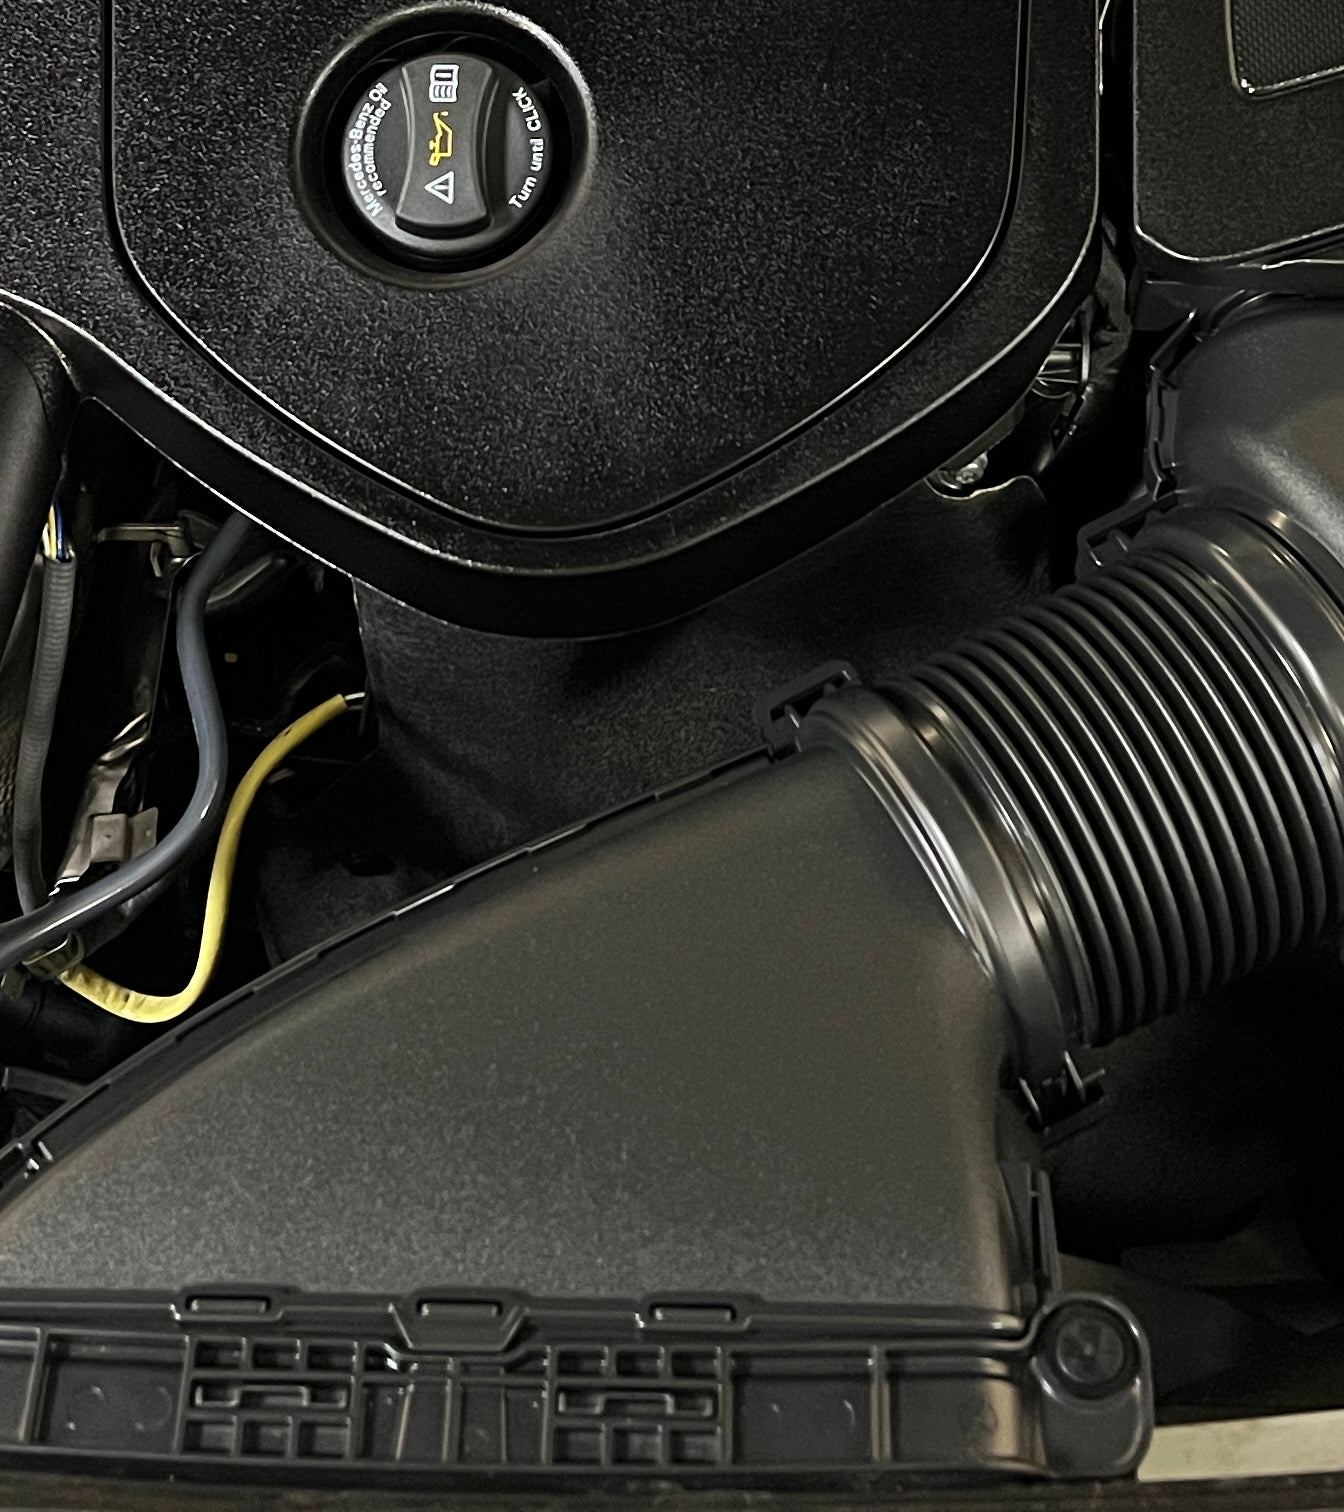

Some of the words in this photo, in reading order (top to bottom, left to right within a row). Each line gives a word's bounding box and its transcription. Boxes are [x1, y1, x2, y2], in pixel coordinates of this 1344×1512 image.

[511, 85, 542, 133] CLICK
[348, 100, 383, 218] Mercedes-Benz
[362, 98, 392, 197] recommended
[529, 137, 544, 172] until
[508, 176, 538, 209] Turn
